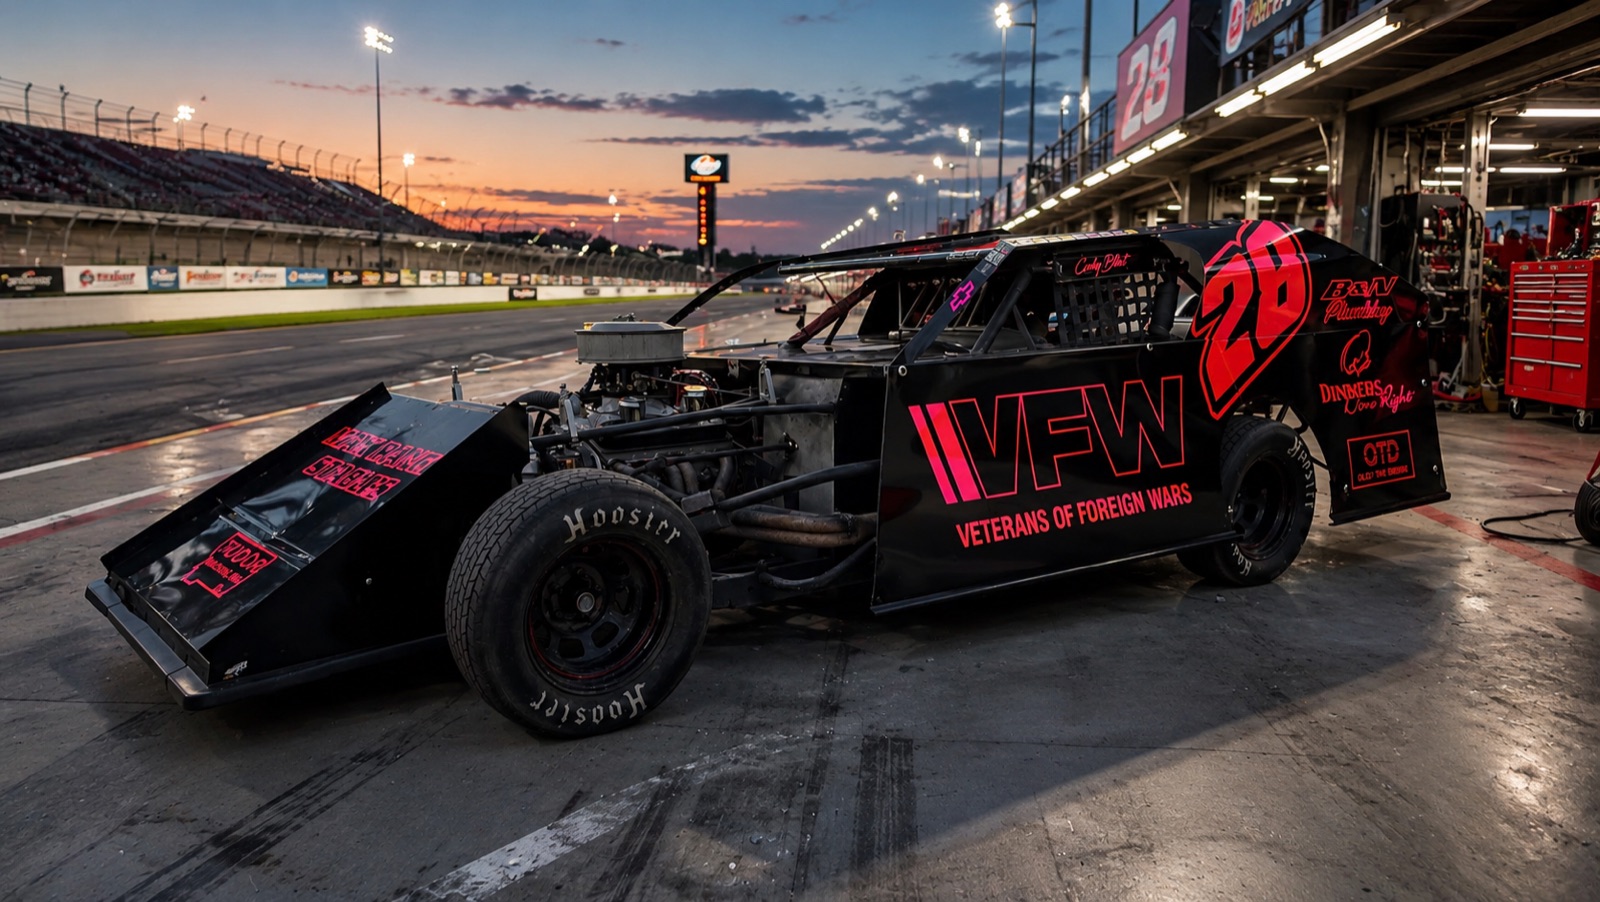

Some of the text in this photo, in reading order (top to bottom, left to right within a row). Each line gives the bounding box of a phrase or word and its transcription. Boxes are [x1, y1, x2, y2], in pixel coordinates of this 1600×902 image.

[1121, 16, 1178, 142] 28
[1202, 219, 1307, 403] 28
[948, 375, 1185, 499] VFW
[1363, 439, 1400, 467] OTD
[562, 505, 681, 545] Hoosier
[955, 482, 1193, 549] VETERANS OF FOREIGN WARS
